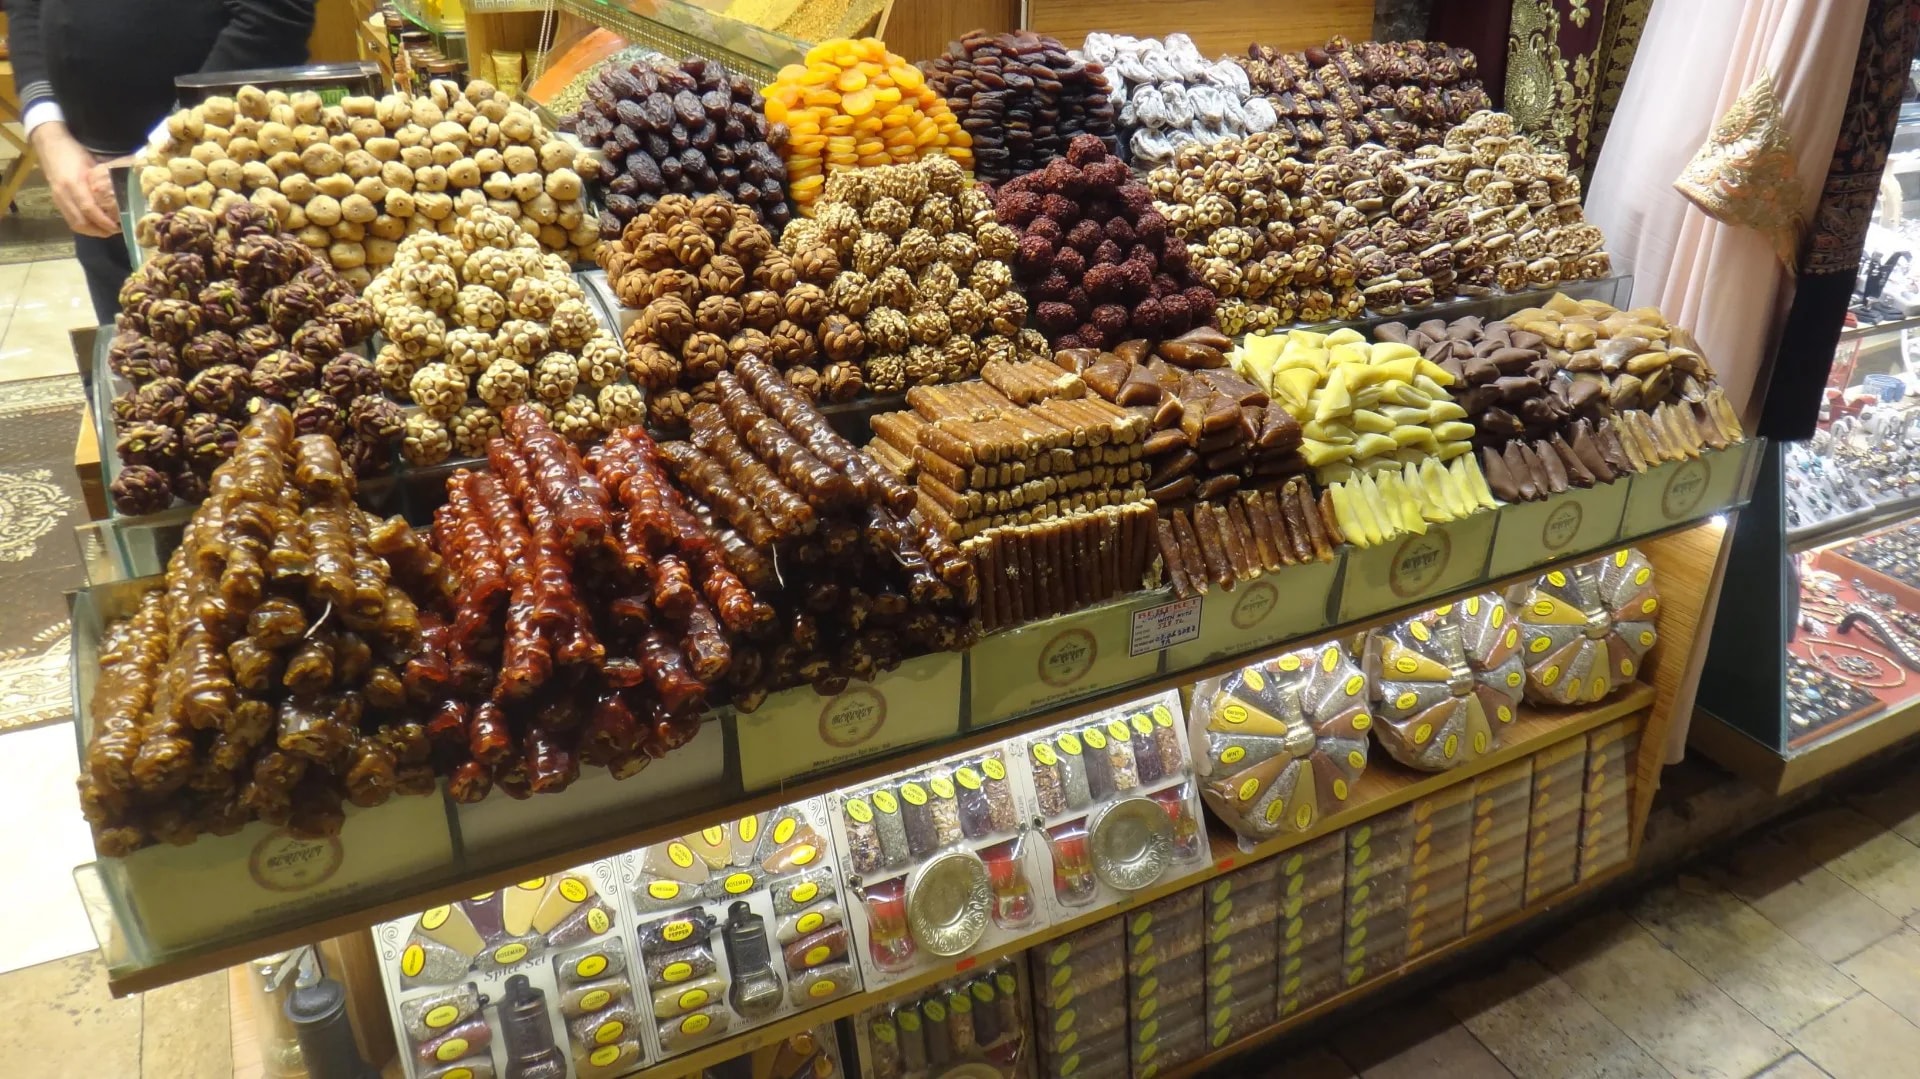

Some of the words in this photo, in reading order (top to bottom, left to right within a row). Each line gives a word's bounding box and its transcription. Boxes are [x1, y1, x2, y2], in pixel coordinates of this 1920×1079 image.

[726, 879, 751, 887] ROSEMARY
[668, 923, 686, 932] BLACK
[667, 928, 689, 938] PEPPER
[496, 946, 525, 958] ROSEMARY
[483, 965, 520, 983] Spice
[525, 956, 546, 970] Set
